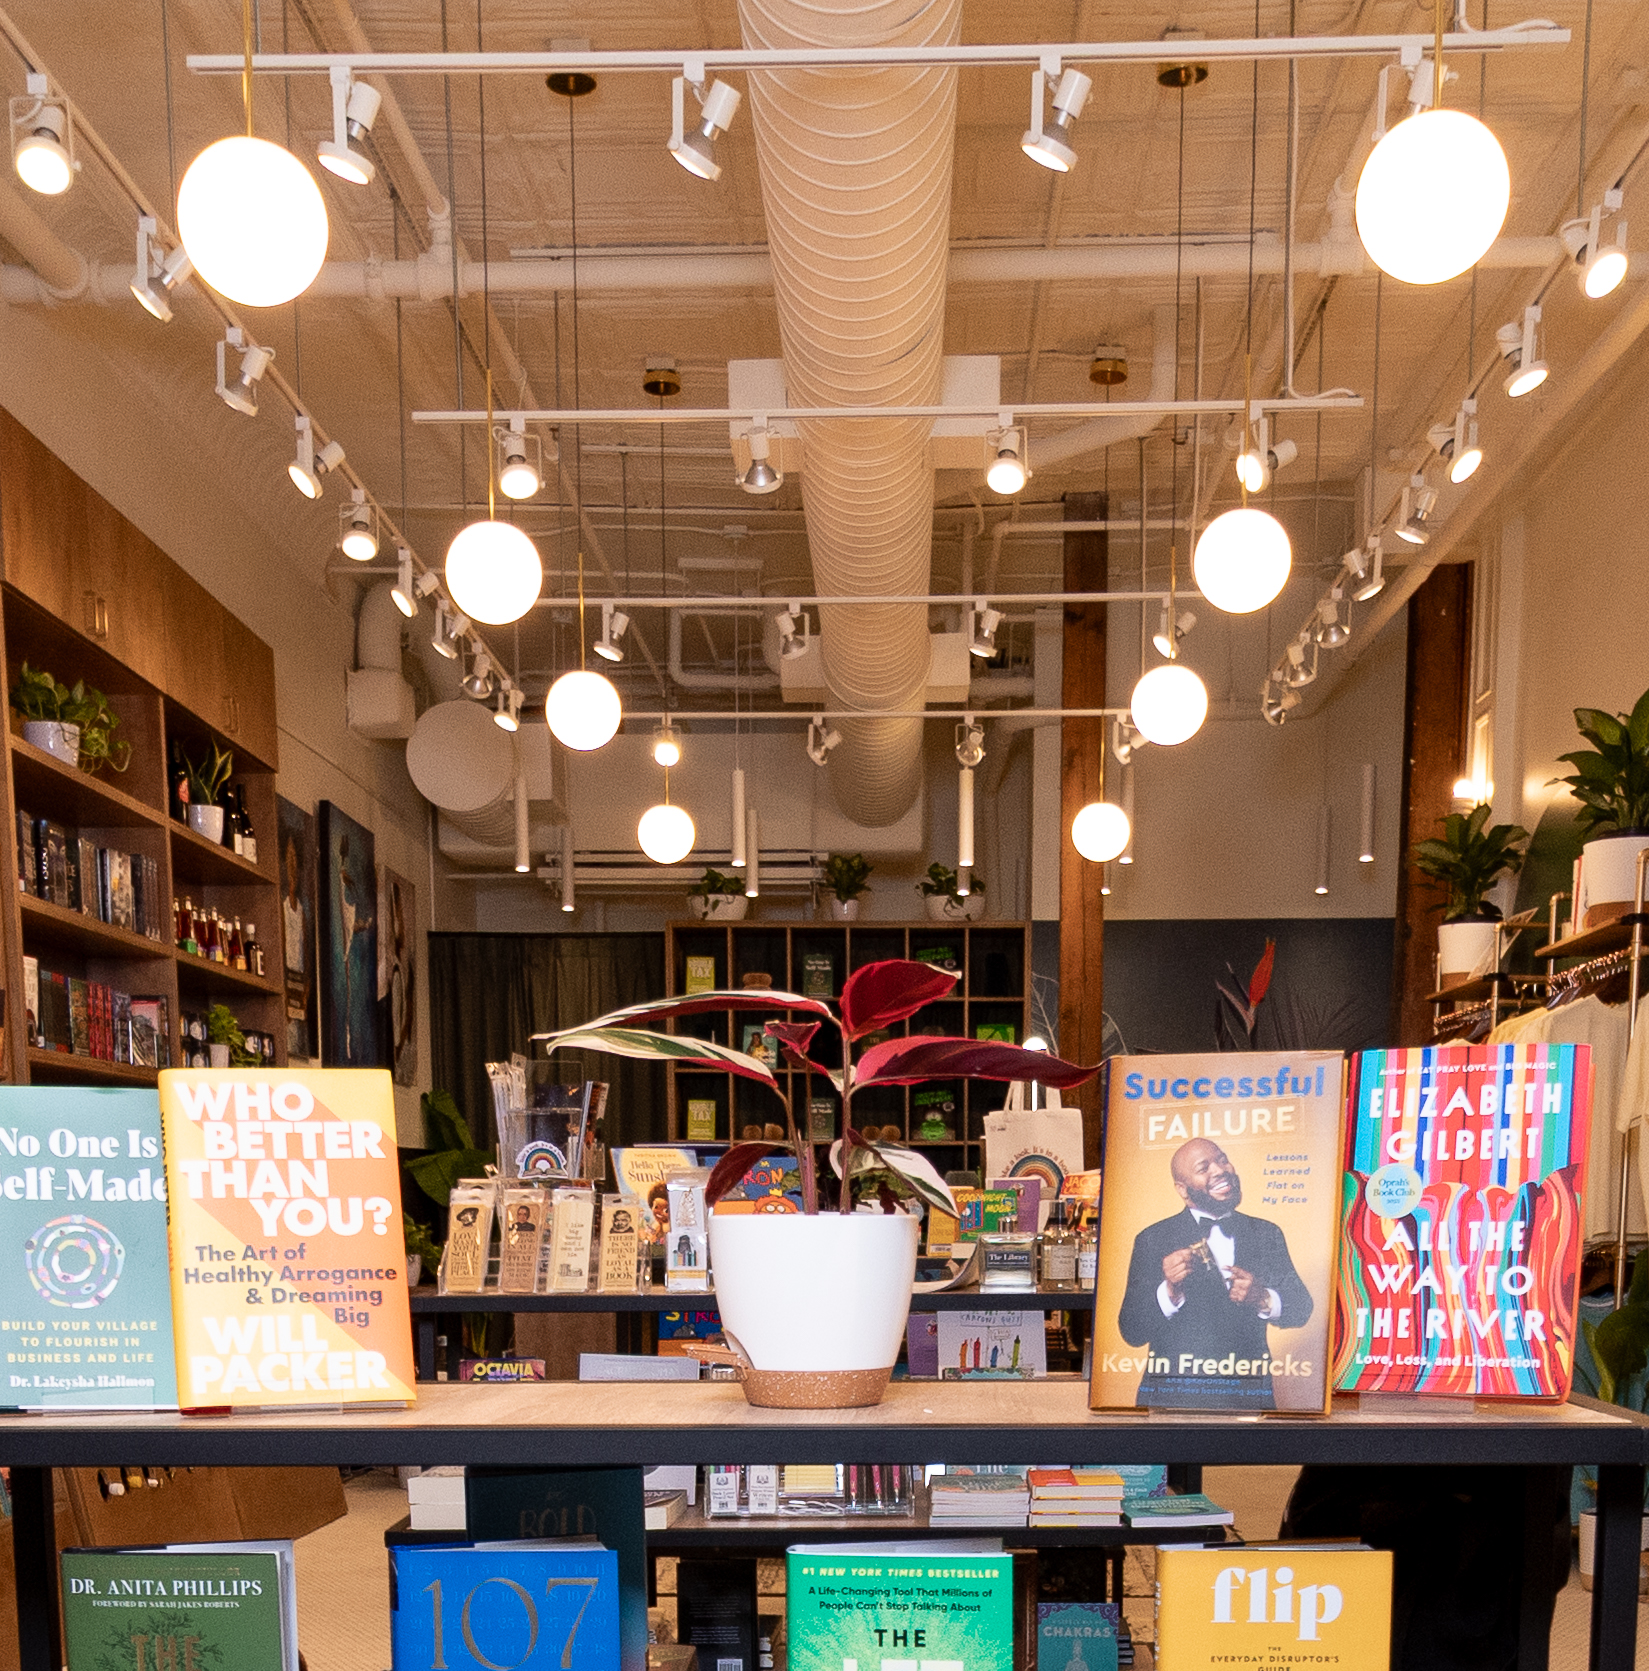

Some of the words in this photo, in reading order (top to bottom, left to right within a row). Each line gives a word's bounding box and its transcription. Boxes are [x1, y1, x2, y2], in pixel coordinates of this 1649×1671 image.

[1124, 1065, 1325, 1100] Successful
[172, 1082, 315, 1122] WHO
[1369, 1083, 1562, 1119] ELIZABETH
[1148, 1105, 1296, 1142] FAILURE
[48, 1129, 120, 1158] One
[127, 1130, 158, 1158] Is
[203, 1122, 387, 1160] BETTER
[1385, 1128, 1540, 1161] GILBERT
[1266, 1153, 1309, 1163] Lessons
[179, 1160, 330, 1199] THAN
[1263, 1166, 1311, 1177] Learned
[956, 1193, 1007, 1203] GOODNIGHT
[985, 1205, 1010, 1213] MOON
[1283, 1195, 1308, 1205] Face
[253, 1199, 393, 1237] YOU?
[1382, 1220, 1452, 1252] ALL
[1469, 1220, 1526, 1252] THE
[195, 1245, 236, 1262] The
[241, 1245, 278, 1262] Art
[283, 1243, 306, 1261] of
[989, 1253, 1002, 1262] The
[1003, 1253, 1028, 1262] Library
[184, 1266, 273, 1287] Healthy
[279, 1265, 397, 1287] Arrogance
[1367, 1266, 1469, 1295] WAY
[1485, 1265, 1533, 1297] TO
[271, 1286, 384, 1307] Dreaming
[1, 1321, 46, 1331] BUILD
[52, 1321, 92, 1331] YOUR
[97, 1321, 158, 1331] VILLAGE
[334, 1307, 370, 1328] Big
[1355, 1308, 1412, 1340] THE
[1425, 1309, 1546, 1341] RIVER
[202, 1314, 329, 1354] WILL
[190, 1351, 390, 1394] PACKER
[473, 1363, 534, 1376] OCTAVIA
[1101, 1352, 1170, 1375] Kevin
[1177, 1353, 1313, 1378] Fredericks
[1355, 1354, 1392, 1369] Love,
[1395, 1354, 1431, 1369] Loss,
[1465, 1354, 1541, 1369] Liberation
[10, 1375, 29, 1388] Dr.
[34, 1375, 94, 1389] Lakeysha
[98, 1375, 155, 1388] Hallmon
[69, 1578, 103, 1596] DR.
[107, 1578, 170, 1596] ANITA
[172, 1578, 262, 1596] PHILLIPS
[1211, 1566, 1344, 1640] flip
[421, 1577, 599, 1671] 107
[1043, 1626, 1112, 1639] CHAKRAS
[1211, 1654, 1263, 1664] EVERYDAY
